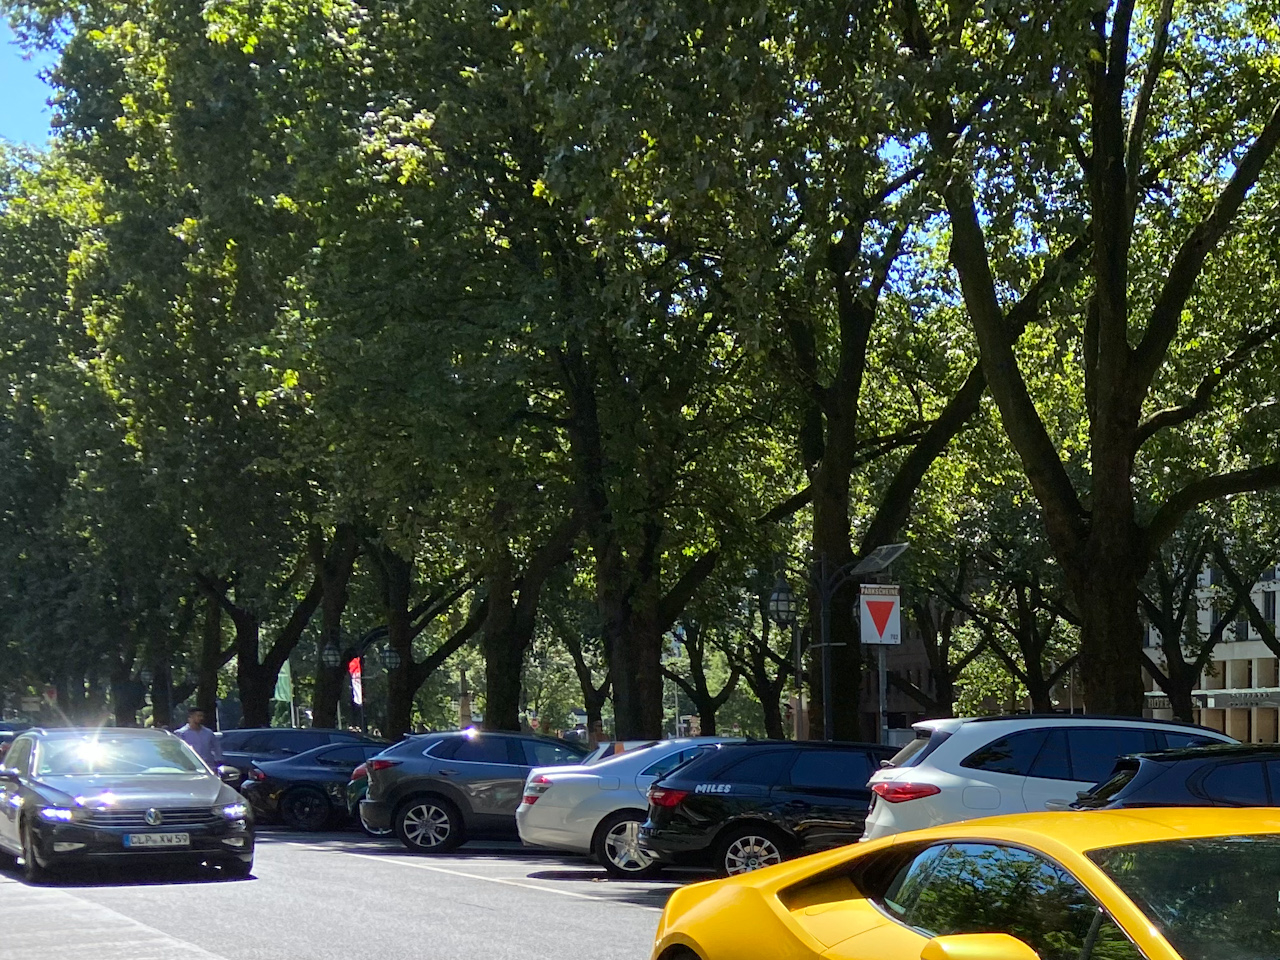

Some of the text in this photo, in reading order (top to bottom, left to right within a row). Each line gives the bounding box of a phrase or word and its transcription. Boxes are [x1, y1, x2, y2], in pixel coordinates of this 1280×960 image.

[860, 588, 898, 596] PARKSCHEINE
[695, 784, 731, 793] MILES
[130, 835, 152, 845] CLP
[175, 834, 188, 844] 59
